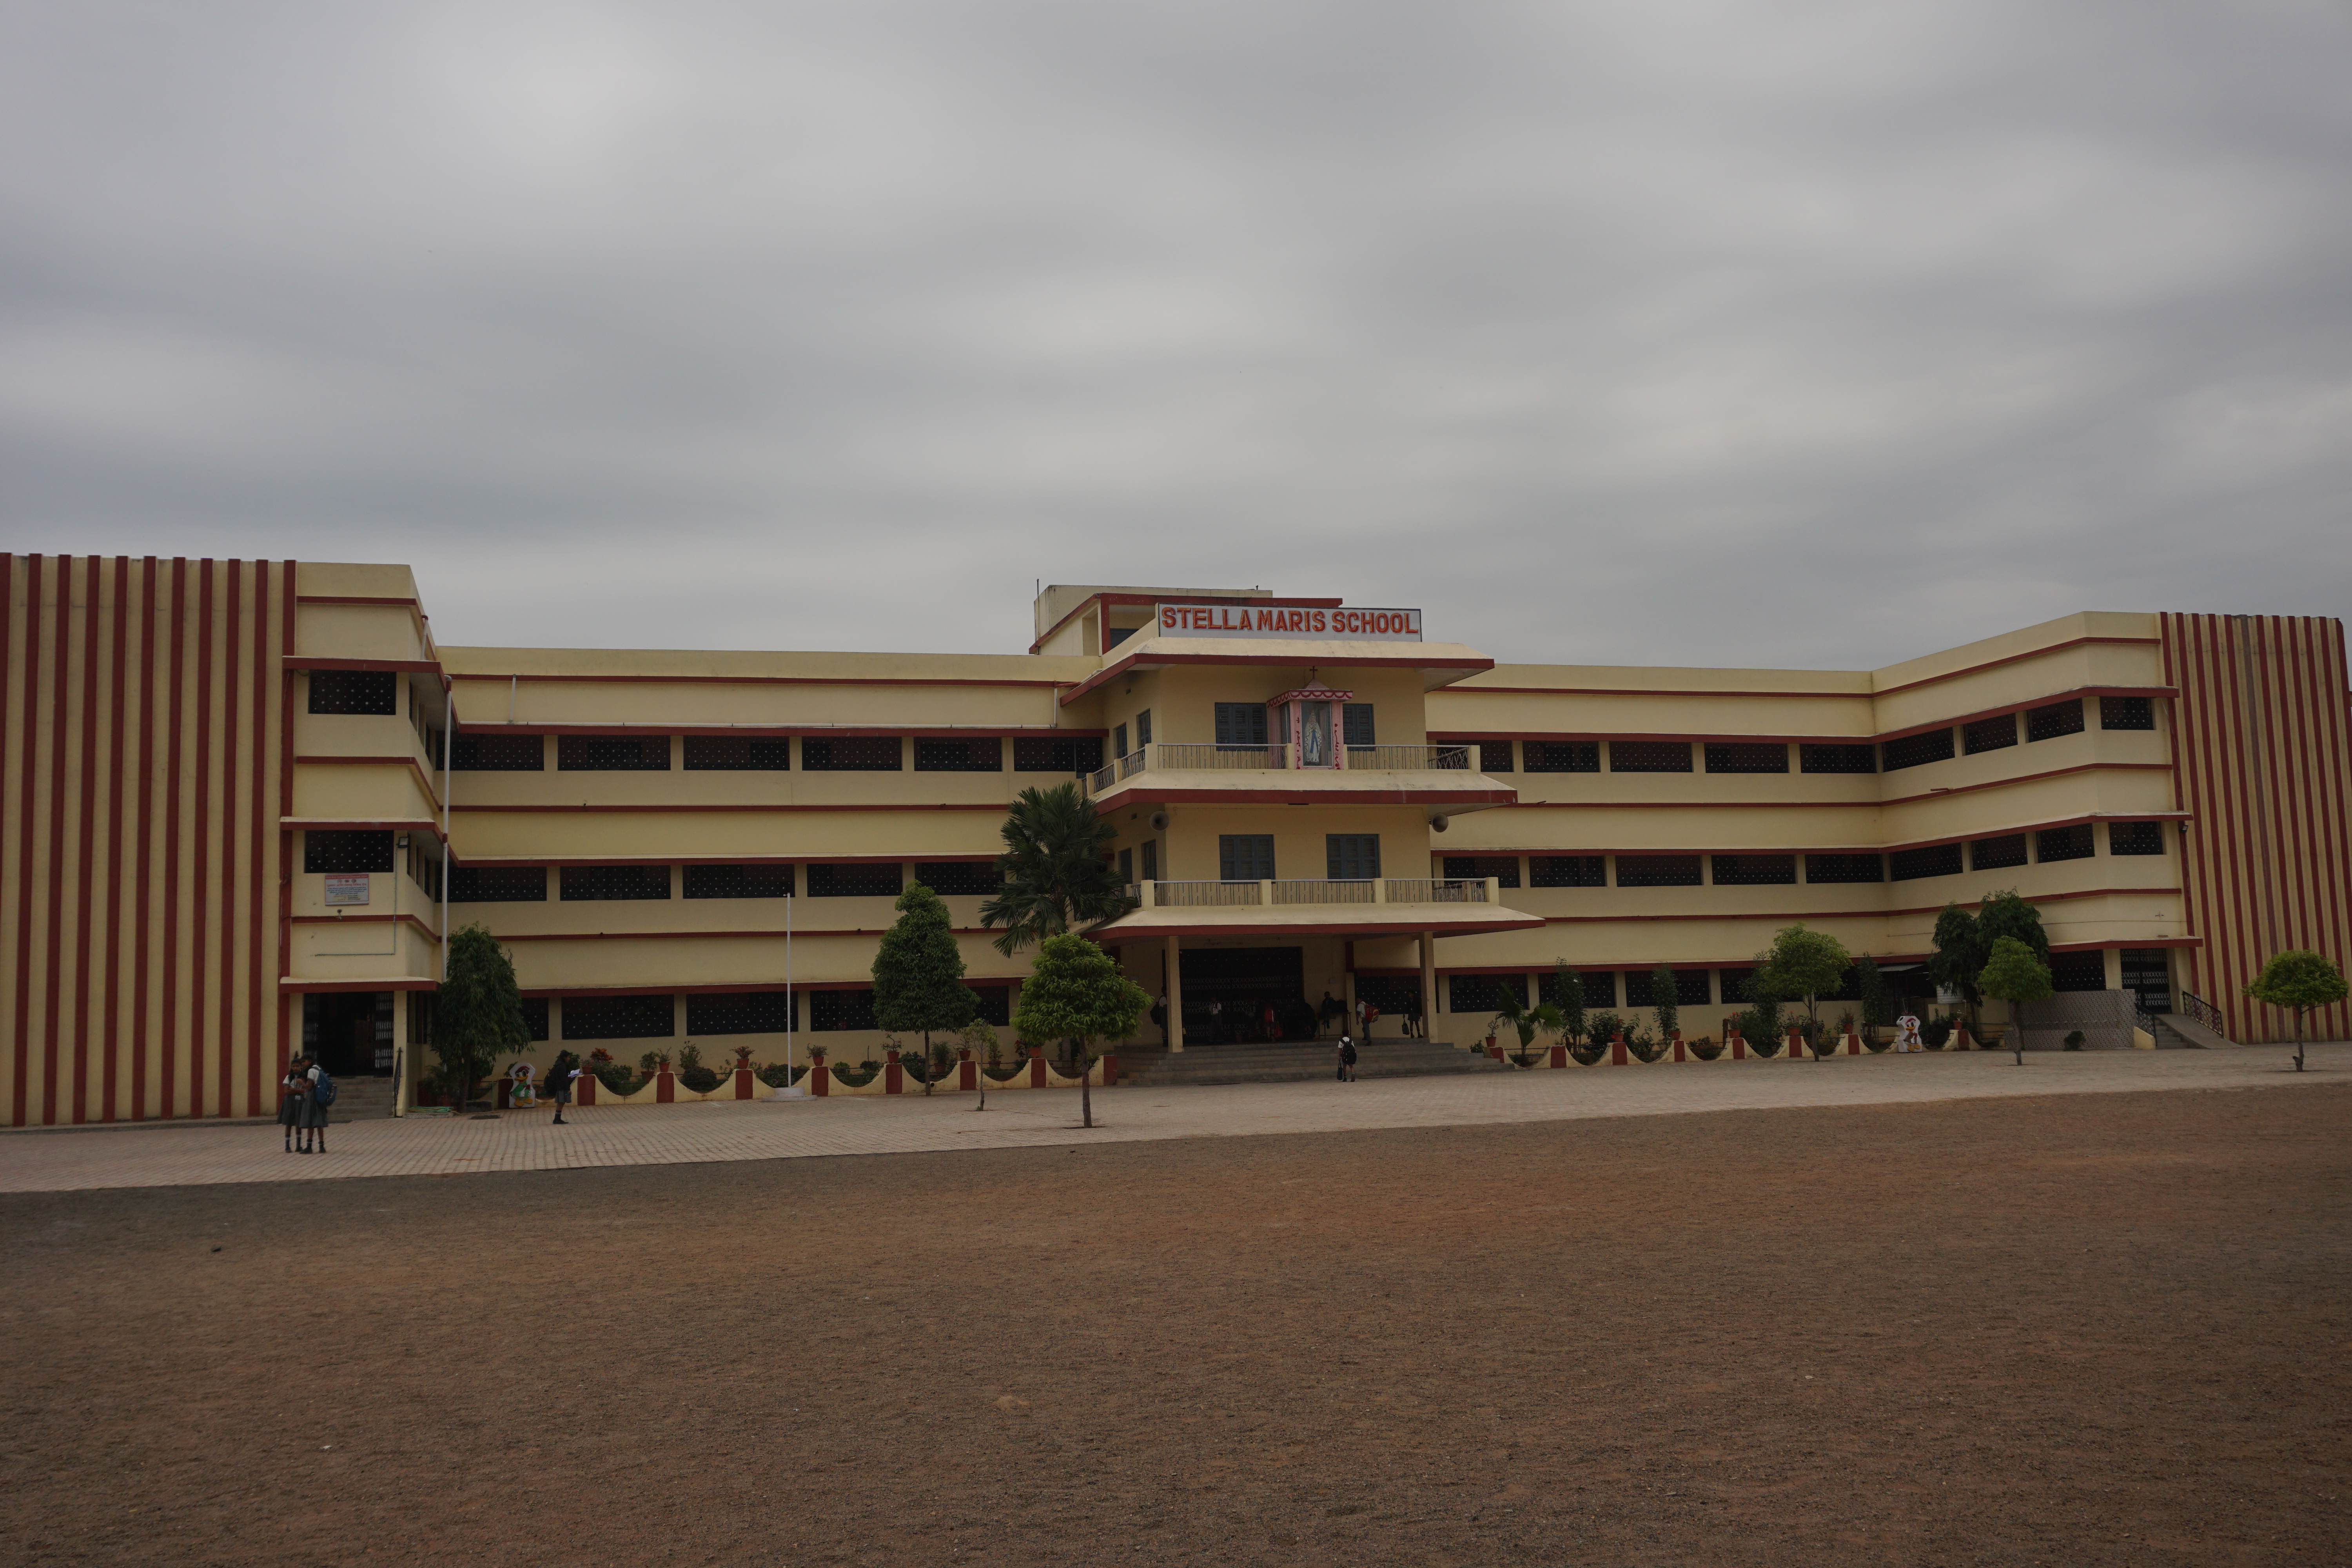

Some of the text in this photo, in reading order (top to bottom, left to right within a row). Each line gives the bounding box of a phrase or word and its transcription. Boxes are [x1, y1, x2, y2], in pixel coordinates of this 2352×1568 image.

[1161, 606, 1419, 634] STELLA MARIS SCHOOL
